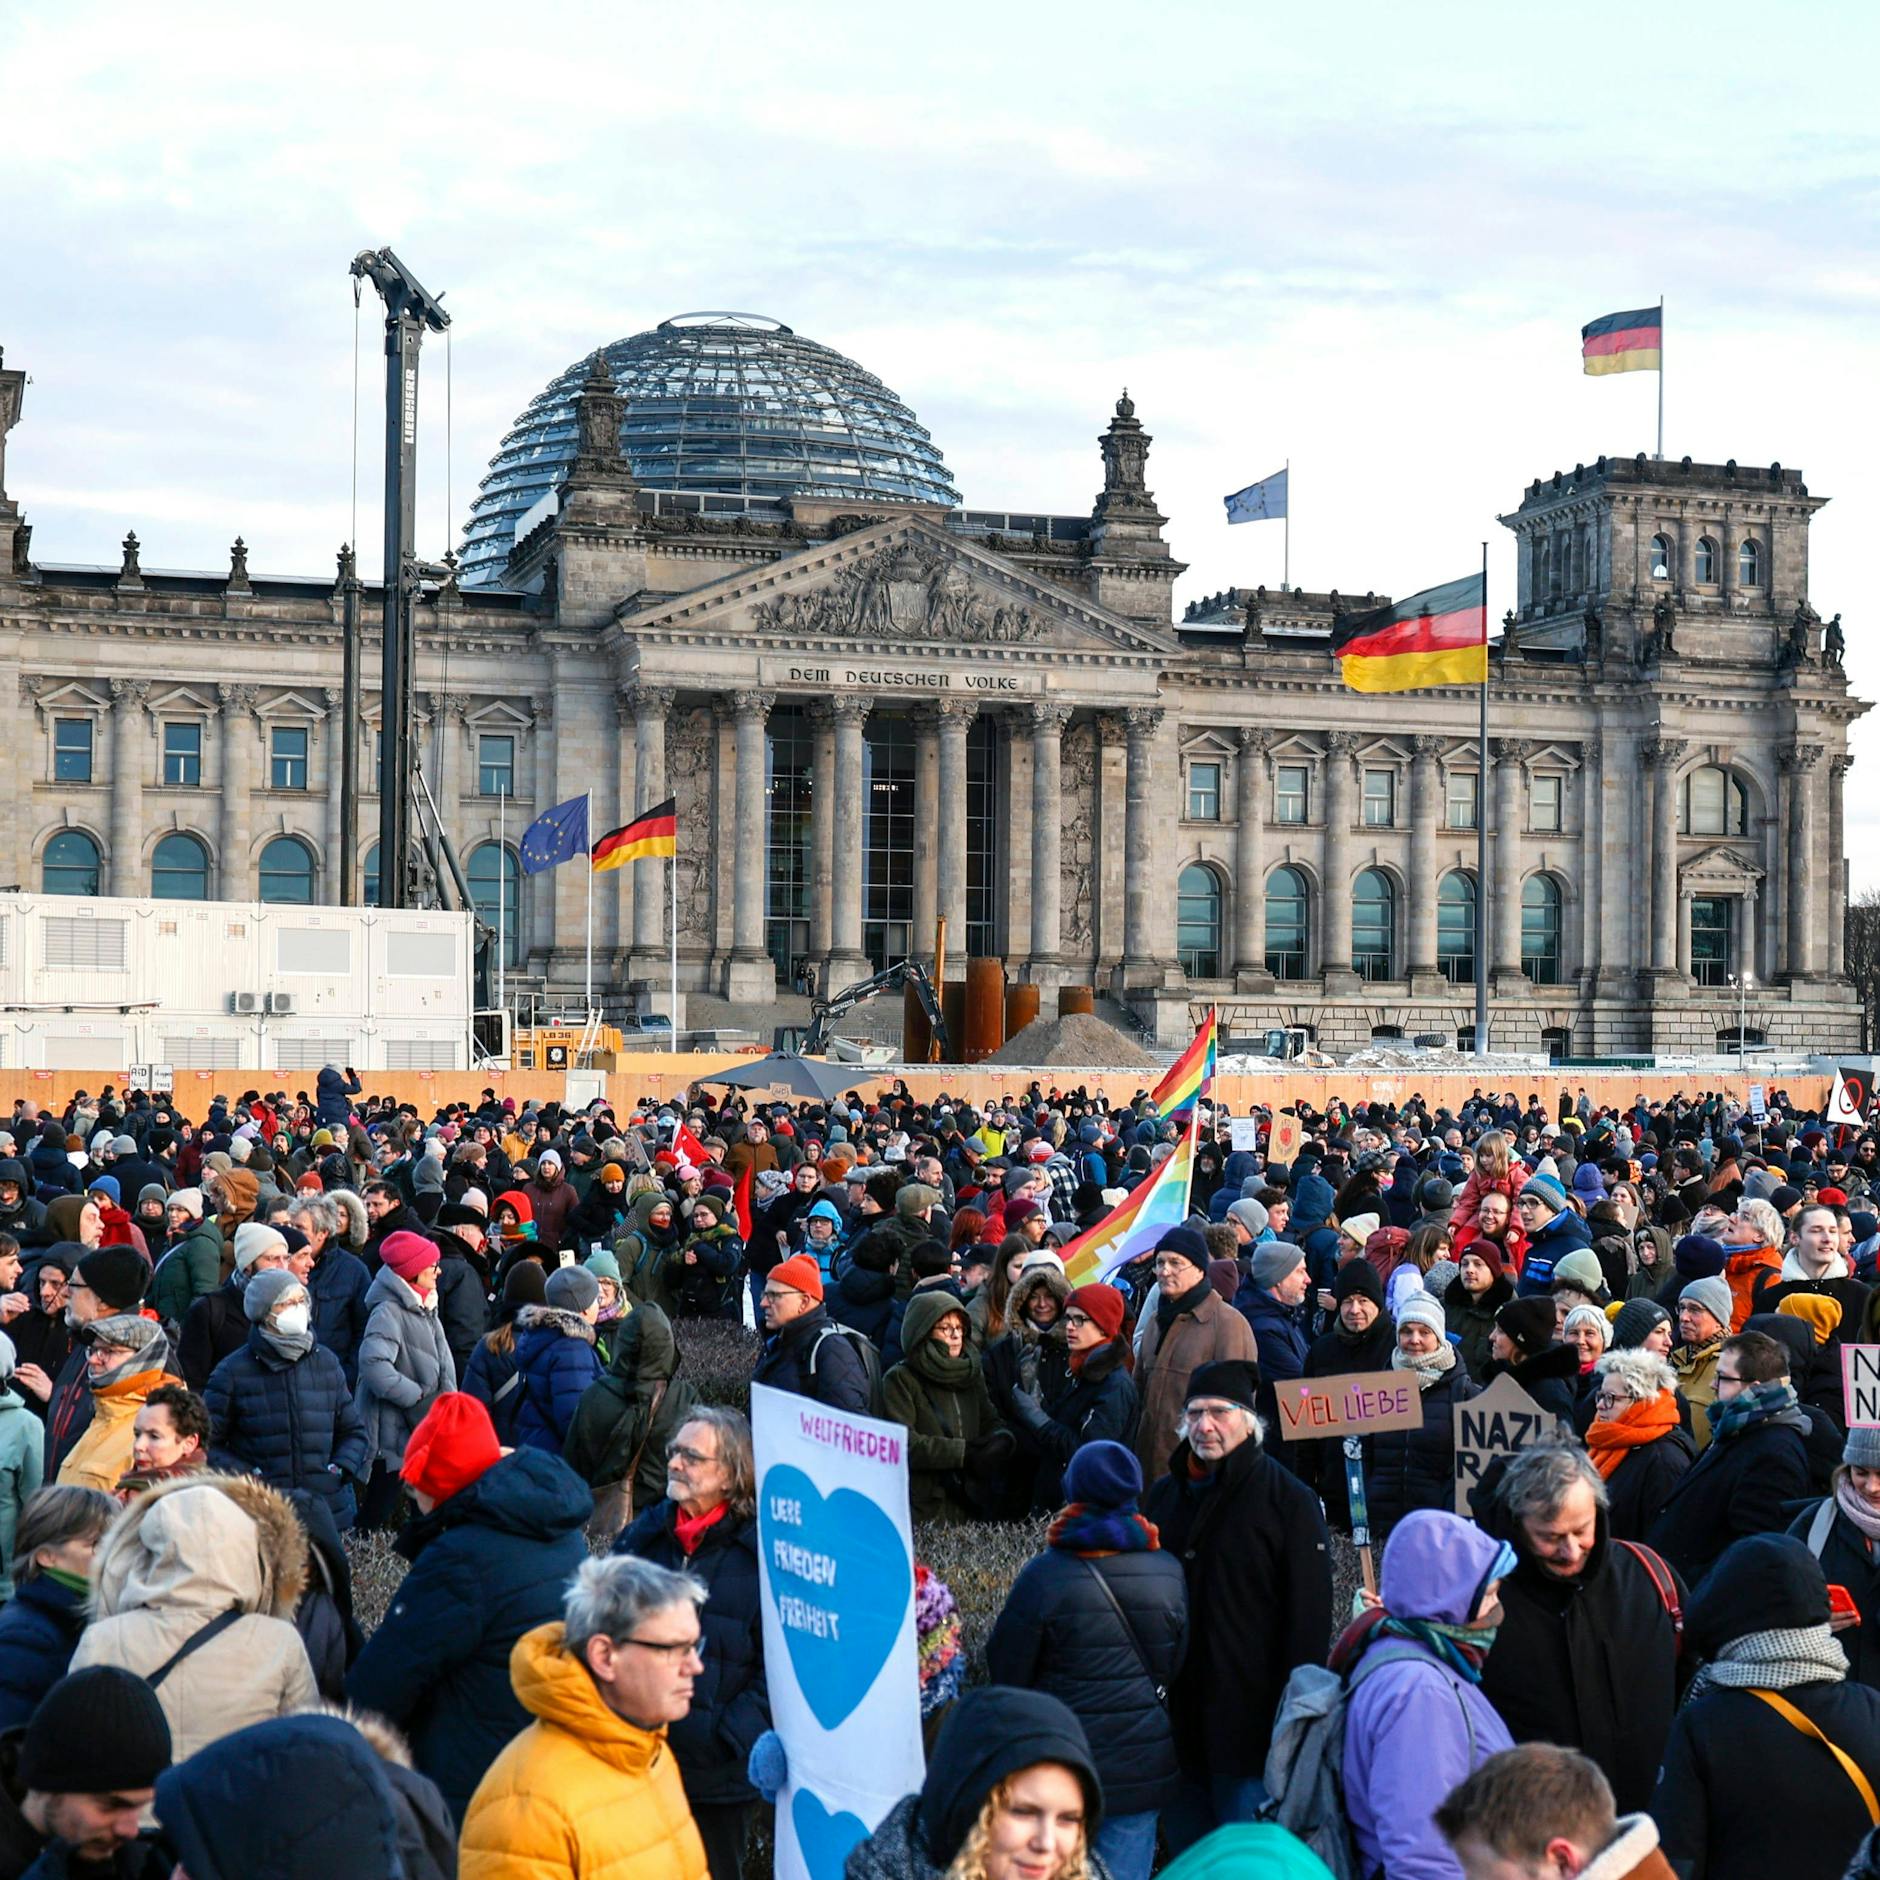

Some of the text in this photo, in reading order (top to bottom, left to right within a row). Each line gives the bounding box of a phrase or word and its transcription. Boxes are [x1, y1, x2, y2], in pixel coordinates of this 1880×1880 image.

[404, 368, 416, 444] LIEBHERR
[789, 667, 1018, 690] DEM DEUTSCHEN VOLKE
[543, 1031, 556, 1039] LB
[1280, 1386, 1409, 1427] VIEL LIEBE
[799, 1411, 900, 1465] WELTFRIEDEN
[1461, 1409, 1542, 1453] NAZI
[773, 1538, 837, 1588] FRIEDEN
[779, 1594, 840, 1642] FREIHEIT
